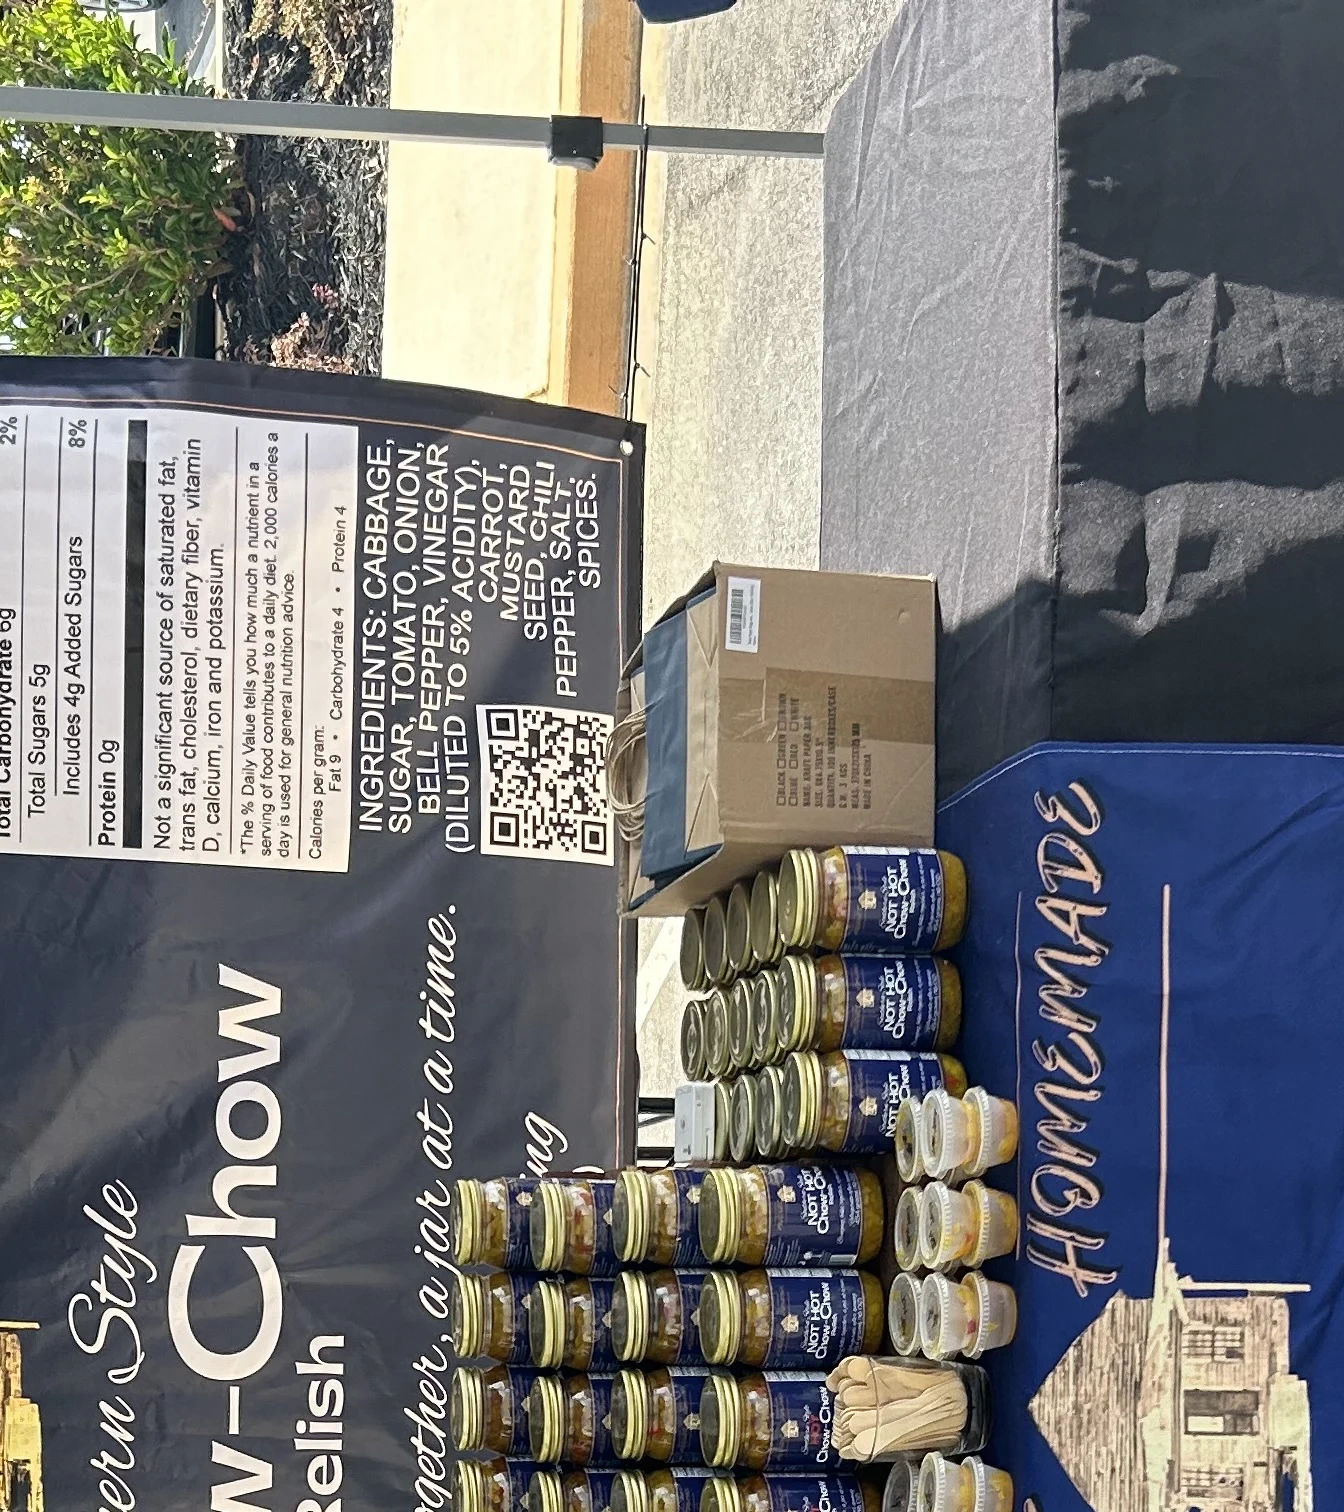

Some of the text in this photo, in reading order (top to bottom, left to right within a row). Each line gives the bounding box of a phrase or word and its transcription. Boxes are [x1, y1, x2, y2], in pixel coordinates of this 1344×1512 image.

[0, 417, 17, 444] 2%
[479, 464, 507, 602] CARROT,
[500, 464, 530, 620] MUSTARD
[524, 462, 555, 640] SEED, CHILI
[576, 474, 600, 588] SPICES.
[63, 420, 87, 795] Includes 4g Added Sugars 8%
[359, 440, 394, 831] INGREDIENTS: CABBAGE,
[389, 443, 424, 833] SUGAR, TOMATO, ONION,
[416, 444, 448, 813] BELL PEPPER, VINEGAR
[444, 460, 482, 852] (DILUTED TO 5% ACIDITY),
[551, 570, 577, 697] PEPPER,
[28, 664, 50, 818] Total Sugars 5g
[98, 740, 119, 846] Protein 0g
[884, 898, 898, 931] NOT
[894, 858, 909, 939] Chow-Chow
[419, 905, 456, 1042] time.
[883, 998, 896, 1030] NOT
[892, 960, 907, 1039] Chow-Chow
[424, 1051, 453, 1093] a
[1022, 780, 1113, 1298] HOMEMADE
[417, 1105, 452, 1169] at
[69, 1179, 157, 1384] Style
[414, 1180, 465, 1288] jar
[419, 1277, 448, 1318] a
[806, 1324, 820, 1352] NOT
[816, 1282, 831, 1359] Chow-Chow
